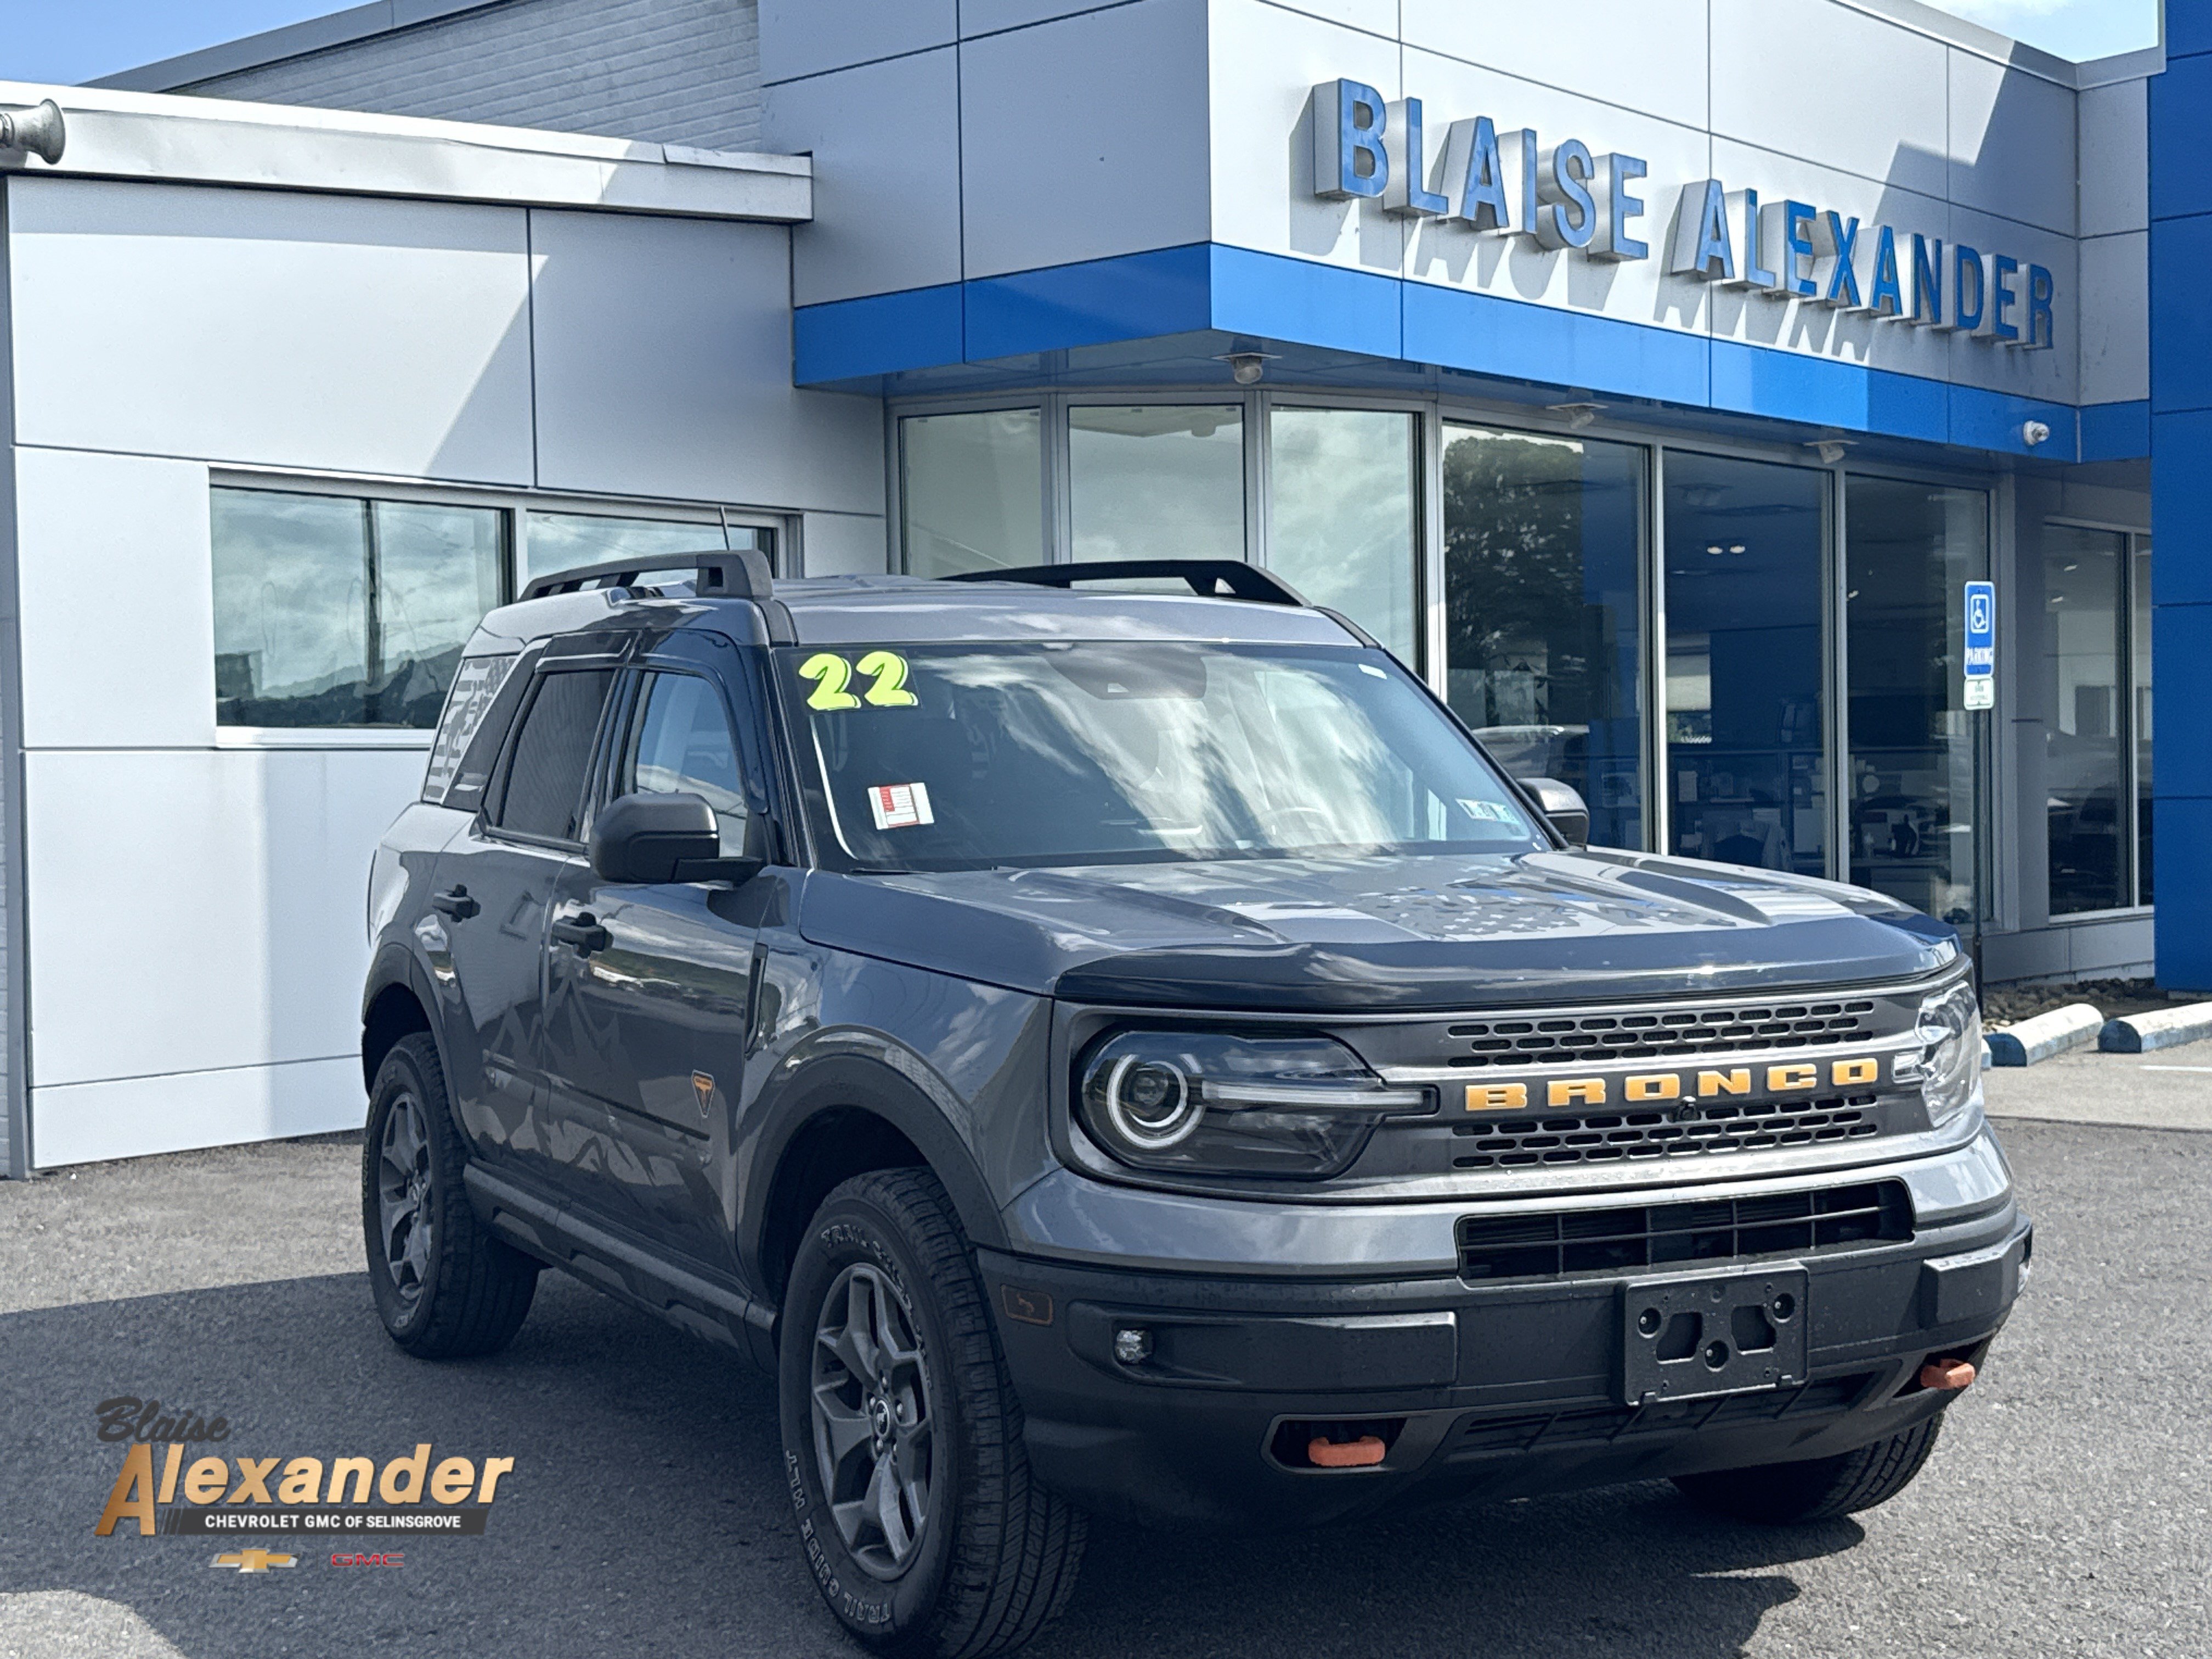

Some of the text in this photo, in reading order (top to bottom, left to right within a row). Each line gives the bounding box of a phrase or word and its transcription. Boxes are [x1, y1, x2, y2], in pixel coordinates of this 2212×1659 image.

[1336, 77, 2054, 349] BLAISE ALEXANDER
[798, 650, 919, 711] 22
[1465, 1058, 1878, 1111] BRONCO
